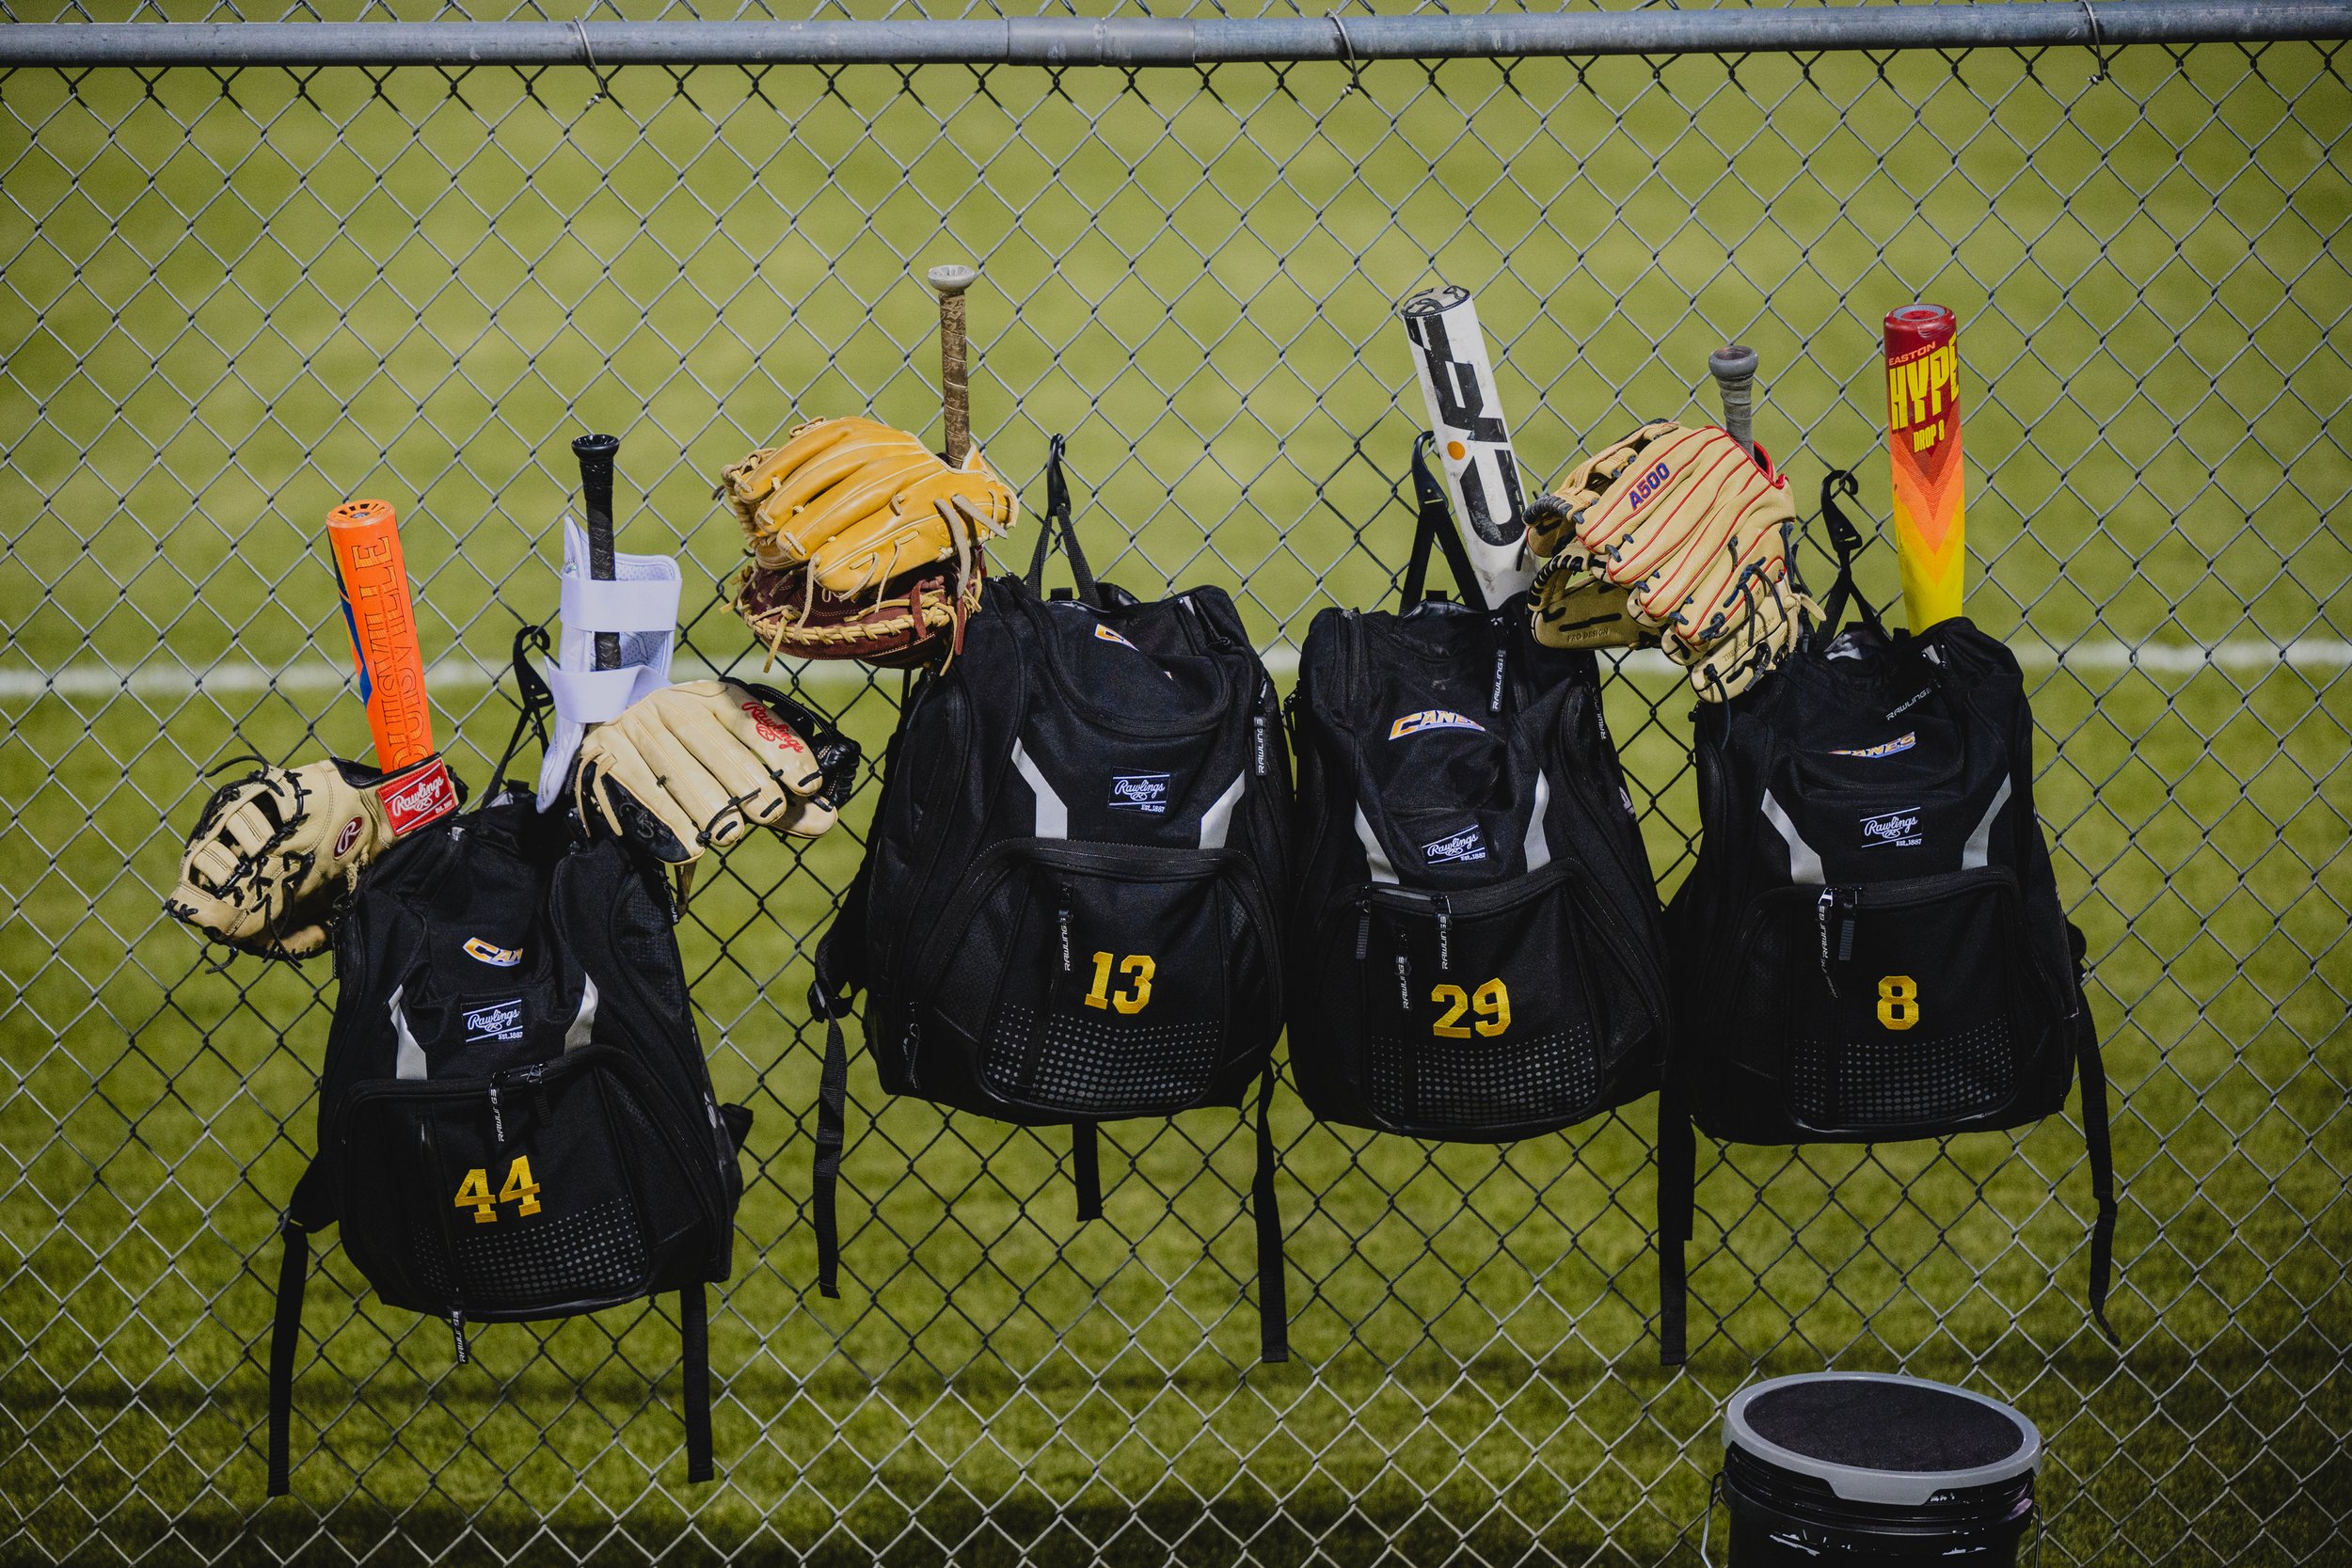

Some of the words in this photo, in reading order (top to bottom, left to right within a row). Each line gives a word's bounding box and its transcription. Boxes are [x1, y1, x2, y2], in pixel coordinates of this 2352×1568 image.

[1889, 341, 1936, 366] EASTON
[1889, 331, 1959, 431] HYPE
[1913, 424, 1936, 452] DROP
[1938, 420, 1944, 441] 8
[1629, 462, 1671, 512] A500
[741, 702, 804, 753] Rawlings
[392, 776, 444, 817] Rawlings
[1115, 780, 1166, 799] Rawlings
[1427, 834, 1478, 856] Rawlings
[1865, 816, 1918, 836] Rawlings
[463, 937, 523, 967] CAN
[1085, 951, 1156, 1014] 13
[1877, 975, 1919, 1031] 8
[468, 1009, 520, 1030] Rawlings
[1431, 977, 1511, 1038] 29
[454, 1155, 541, 1224] 44
